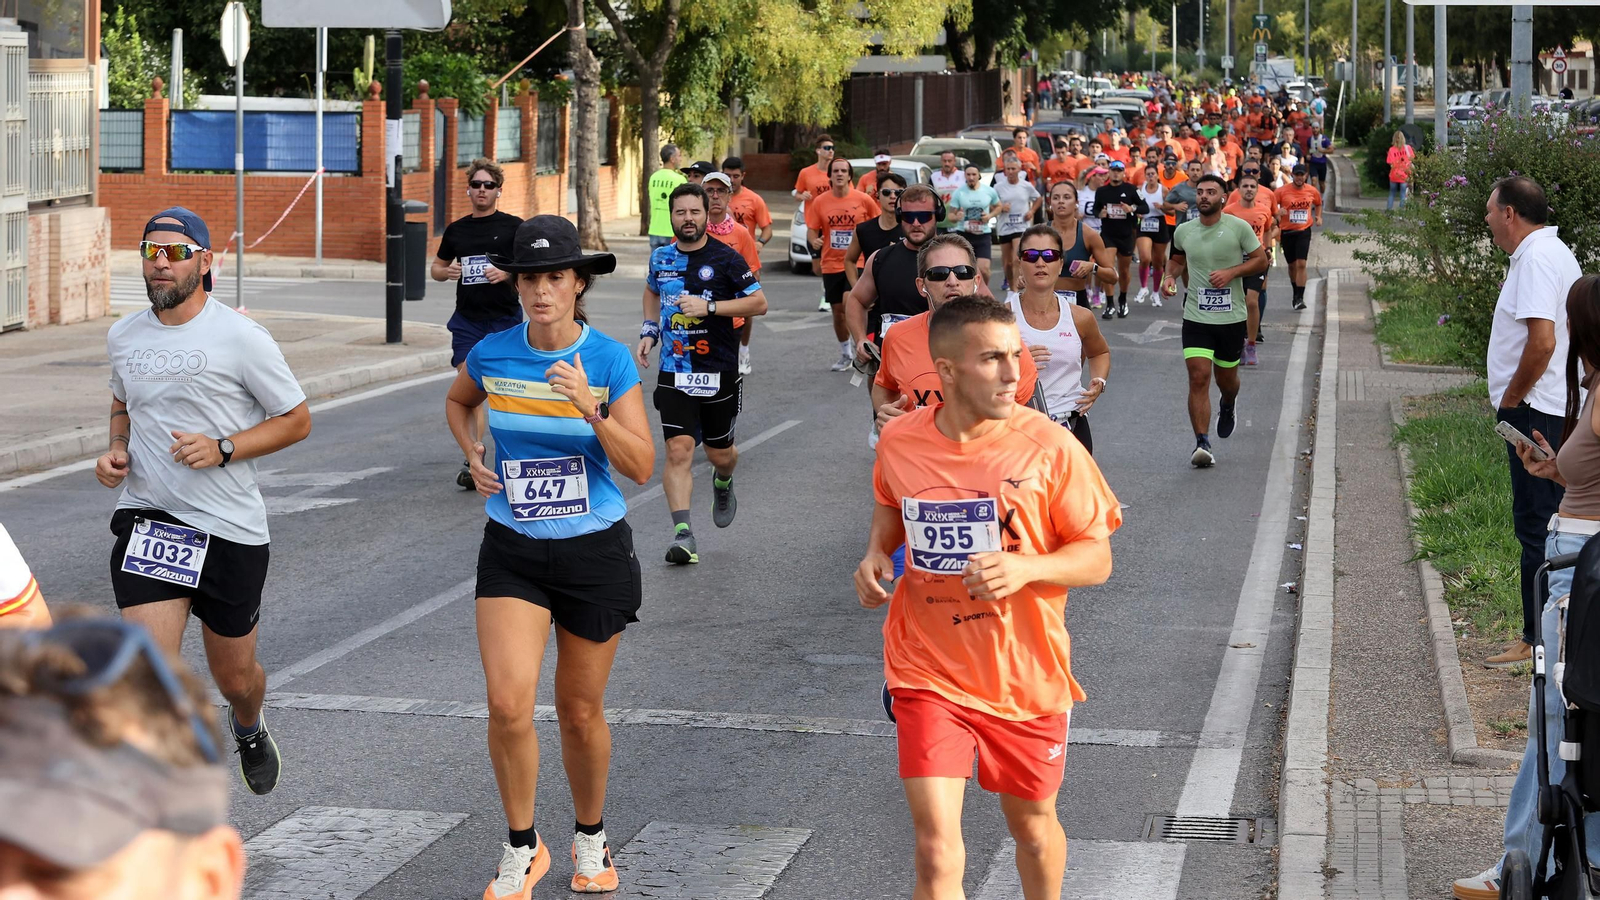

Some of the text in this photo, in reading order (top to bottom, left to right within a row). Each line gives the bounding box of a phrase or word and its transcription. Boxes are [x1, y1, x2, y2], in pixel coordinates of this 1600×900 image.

[653, 180, 674, 189] STAFF
[1205, 296, 1224, 305] 723
[686, 374, 710, 386] 960
[524, 478, 566, 501] 647
[923, 525, 974, 550] 955
[141, 538, 194, 568] 1032
[1007, 543, 1021, 553] DE
